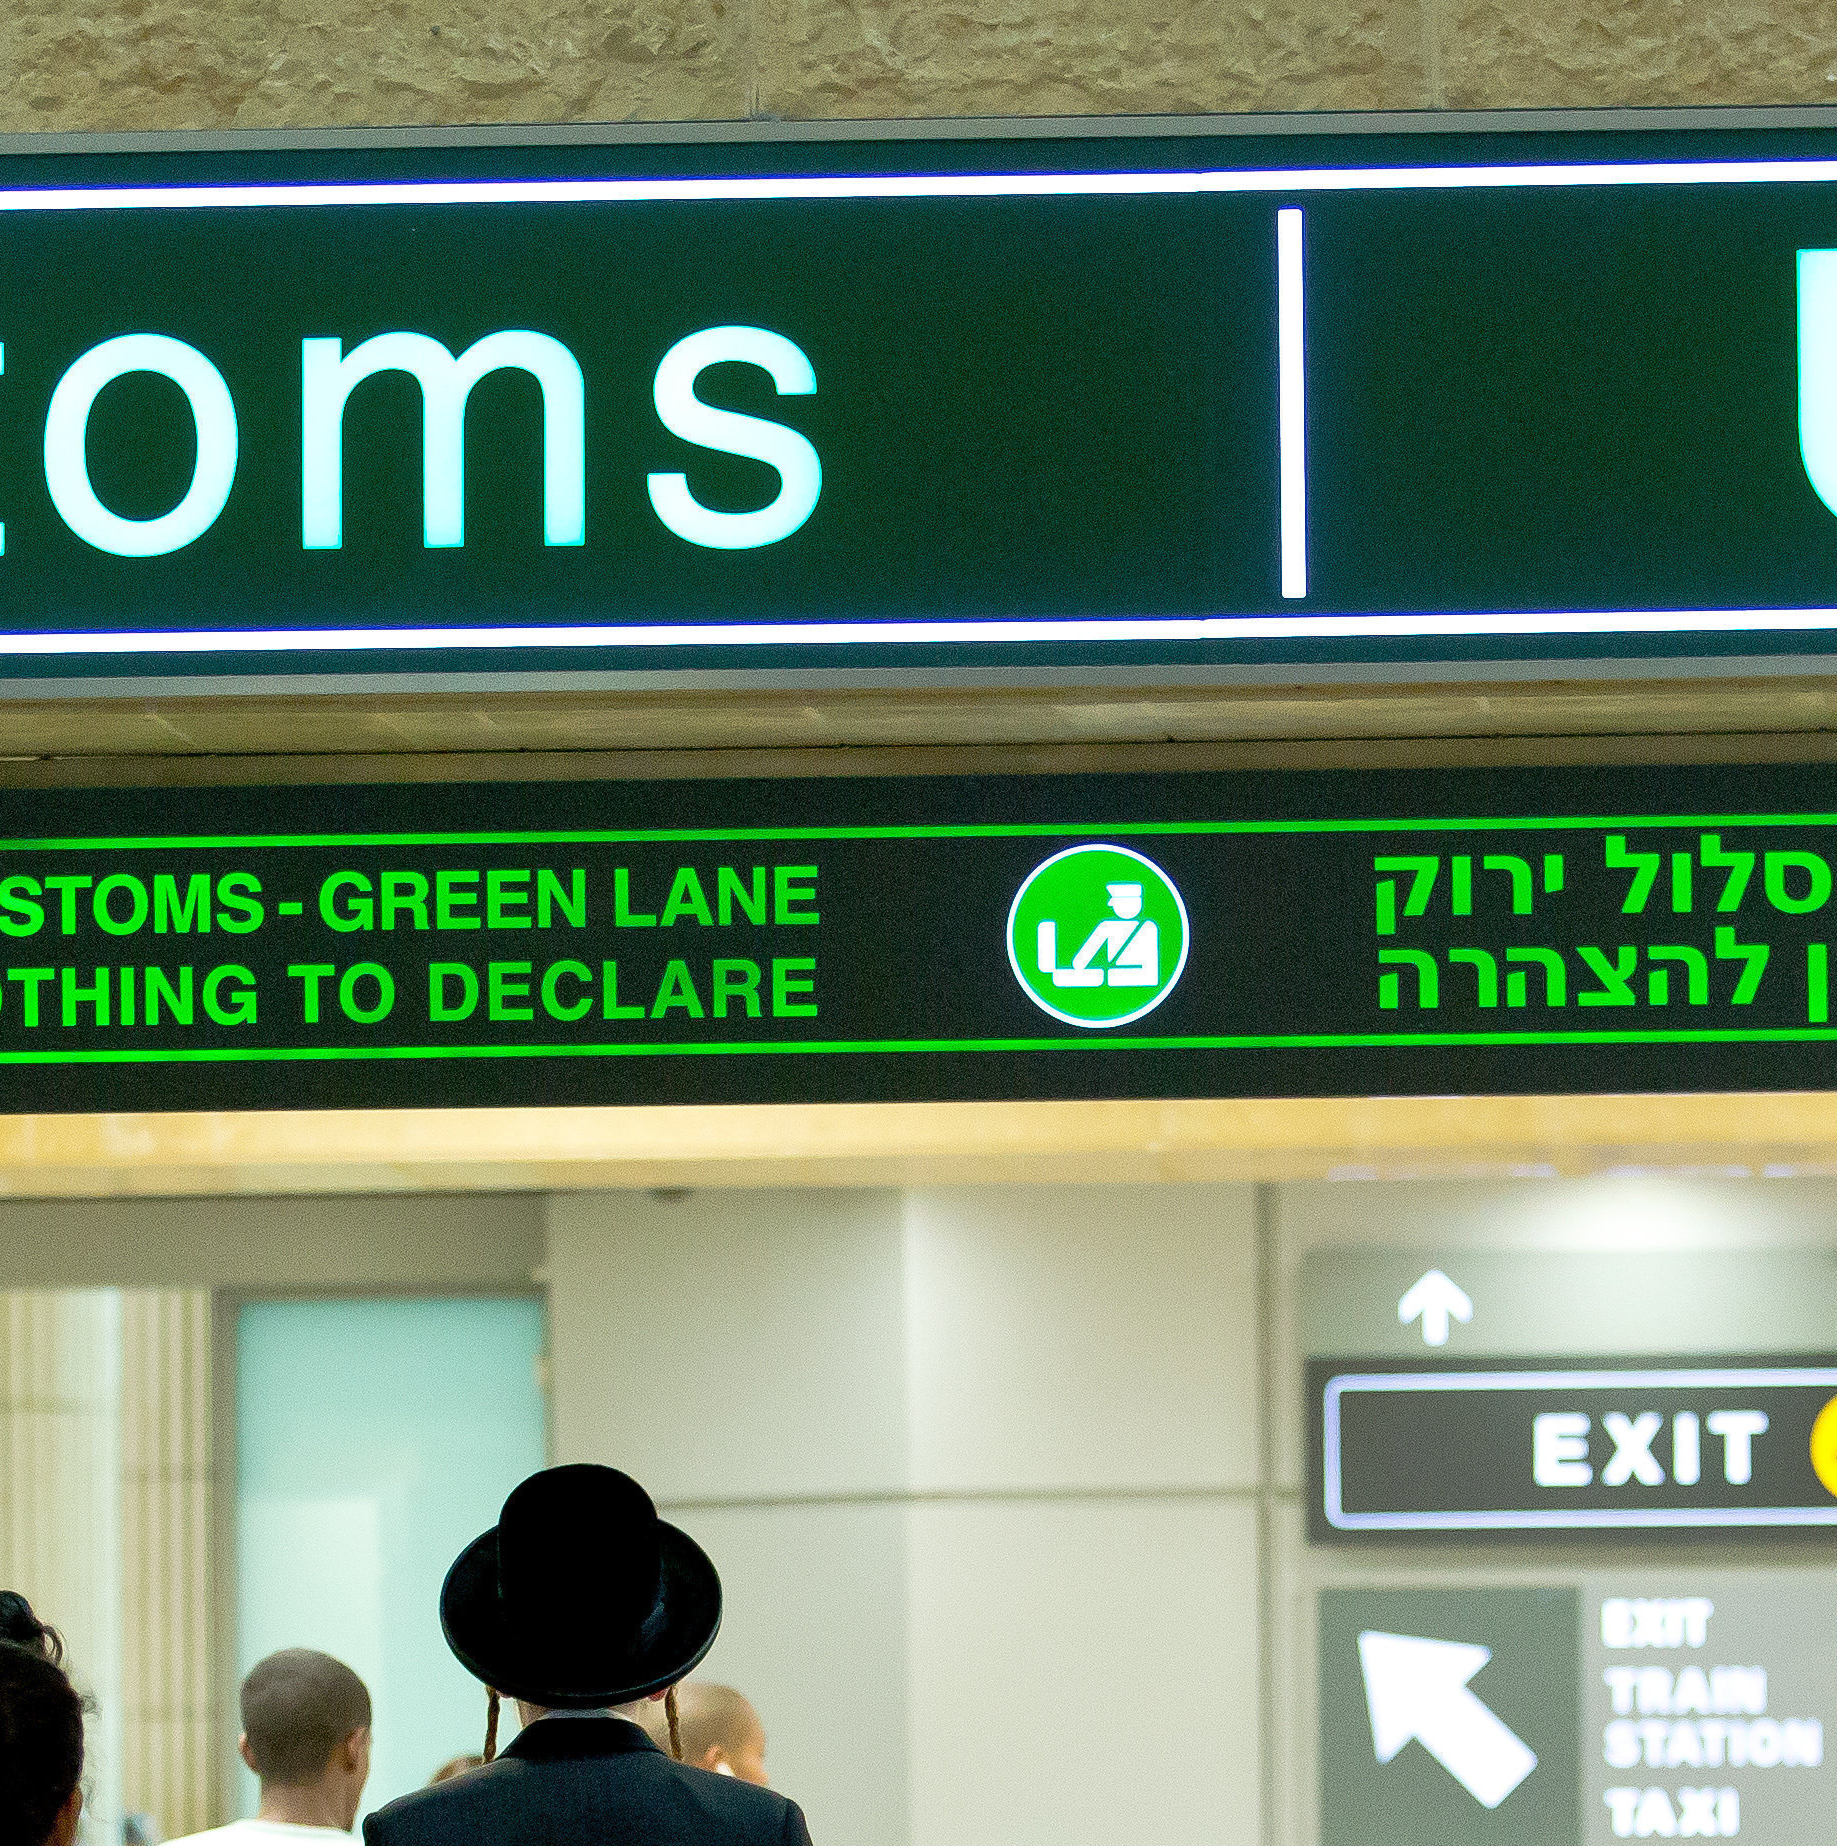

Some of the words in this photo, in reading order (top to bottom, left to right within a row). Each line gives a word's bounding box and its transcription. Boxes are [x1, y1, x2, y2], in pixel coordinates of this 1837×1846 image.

[613, 862, 821, 930] LANE
[1372, 850, 1567, 935] ירוק
[286, 960, 397, 1026] TO
[426, 955, 821, 1022] DECLARE
[1375, 925, 1773, 1012] להצהרה
[1531, 1407, 1769, 1488] EXIT
[1600, 1596, 1714, 1650] EXIT
[1603, 1664, 1767, 1716] TRAIN
[1603, 1717, 1823, 1770] STATION
[1603, 1783, 1740, 1839] TAXI
